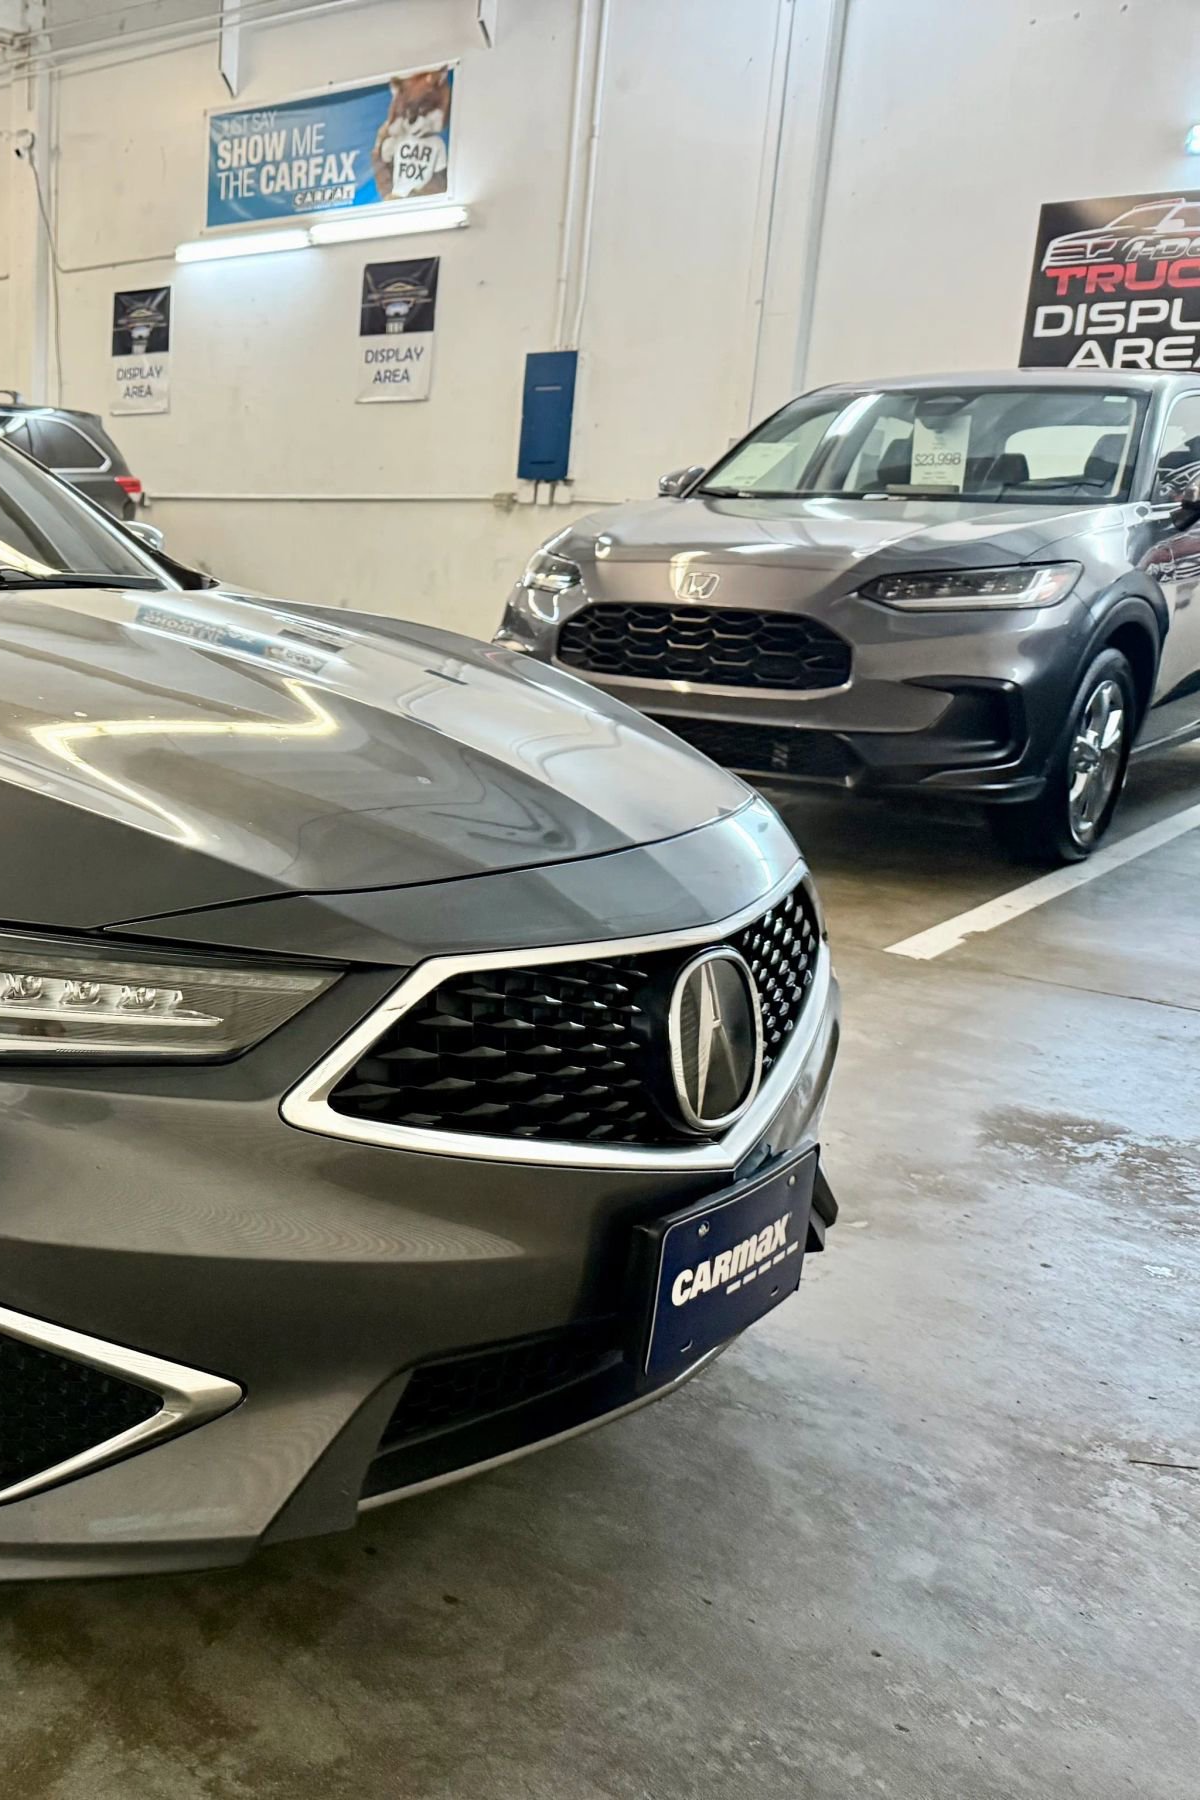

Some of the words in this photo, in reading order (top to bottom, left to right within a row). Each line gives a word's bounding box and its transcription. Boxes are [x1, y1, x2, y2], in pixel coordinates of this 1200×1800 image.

[251, 111, 277, 131] SAY
[217, 130, 286, 170] SHOW
[292, 123, 326, 157] ME
[400, 144, 432, 161] CAR
[217, 167, 257, 200] THE
[260, 150, 359, 195] CARFAX
[399, 163, 428, 181] FOX
[365, 346, 424, 364] DISPLAY
[1066, 336, 1200, 369] ARE
[116, 365, 163, 381] DISPLAY
[373, 369, 411, 385] AREA
[123, 384, 153, 399] AREA
